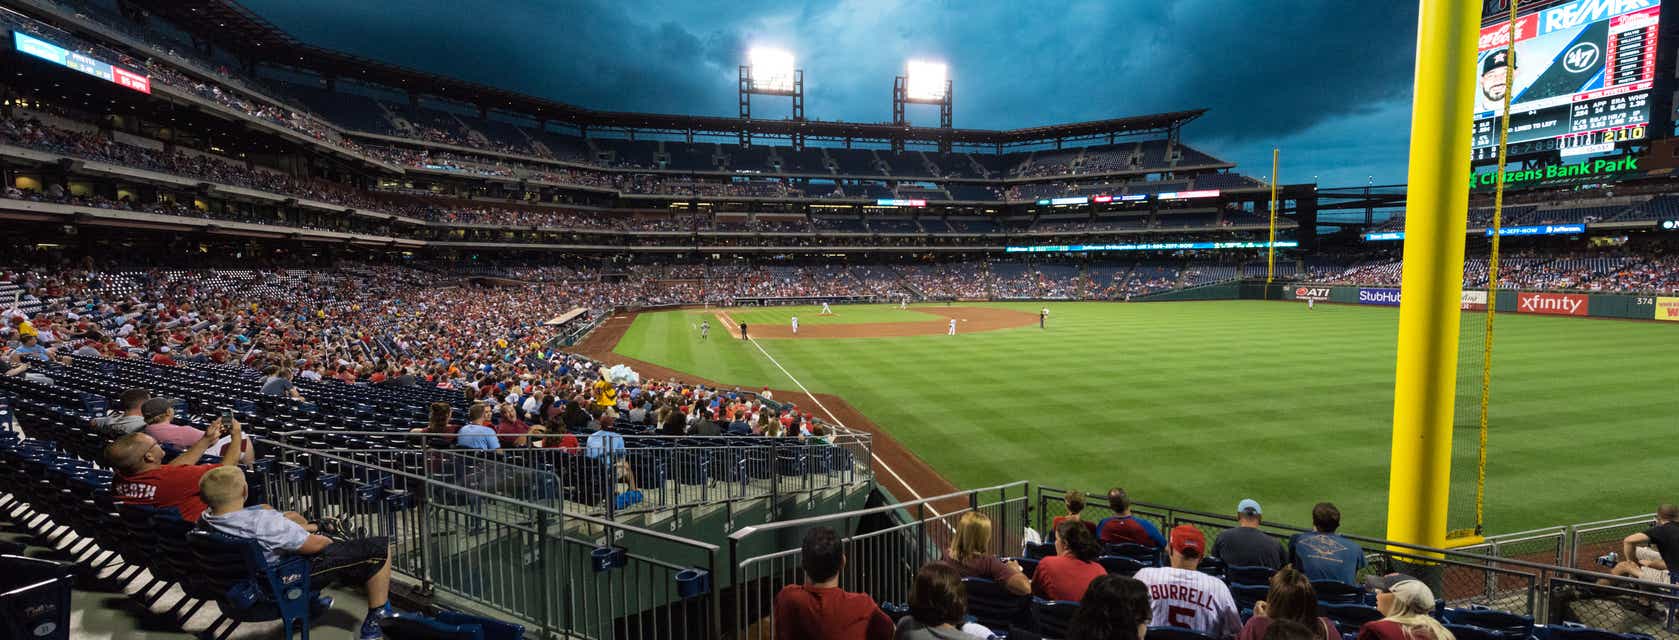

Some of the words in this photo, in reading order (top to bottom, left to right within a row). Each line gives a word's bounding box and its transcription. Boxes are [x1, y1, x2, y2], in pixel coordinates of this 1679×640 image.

[1628, 93, 1649, 102] WHIP
[1533, 122, 1541, 130] TO
[1541, 120, 1557, 128] LEFT
[1604, 132, 1615, 143] 2
[1618, 130, 1628, 141] 1
[1632, 127, 1643, 139] 0
[1480, 168, 1543, 185] Ciizens
[1546, 160, 1591, 177] Bank
[1594, 155, 1638, 174] Park
[1488, 227, 1538, 235] 1-0-JEFF-NOW
[1306, 288, 1330, 297] ATI
[1522, 294, 1583, 313] xfinity
[1636, 297, 1653, 305] 374
[1152, 584, 1215, 612] BURRELL
[1168, 605, 1195, 629] 5
